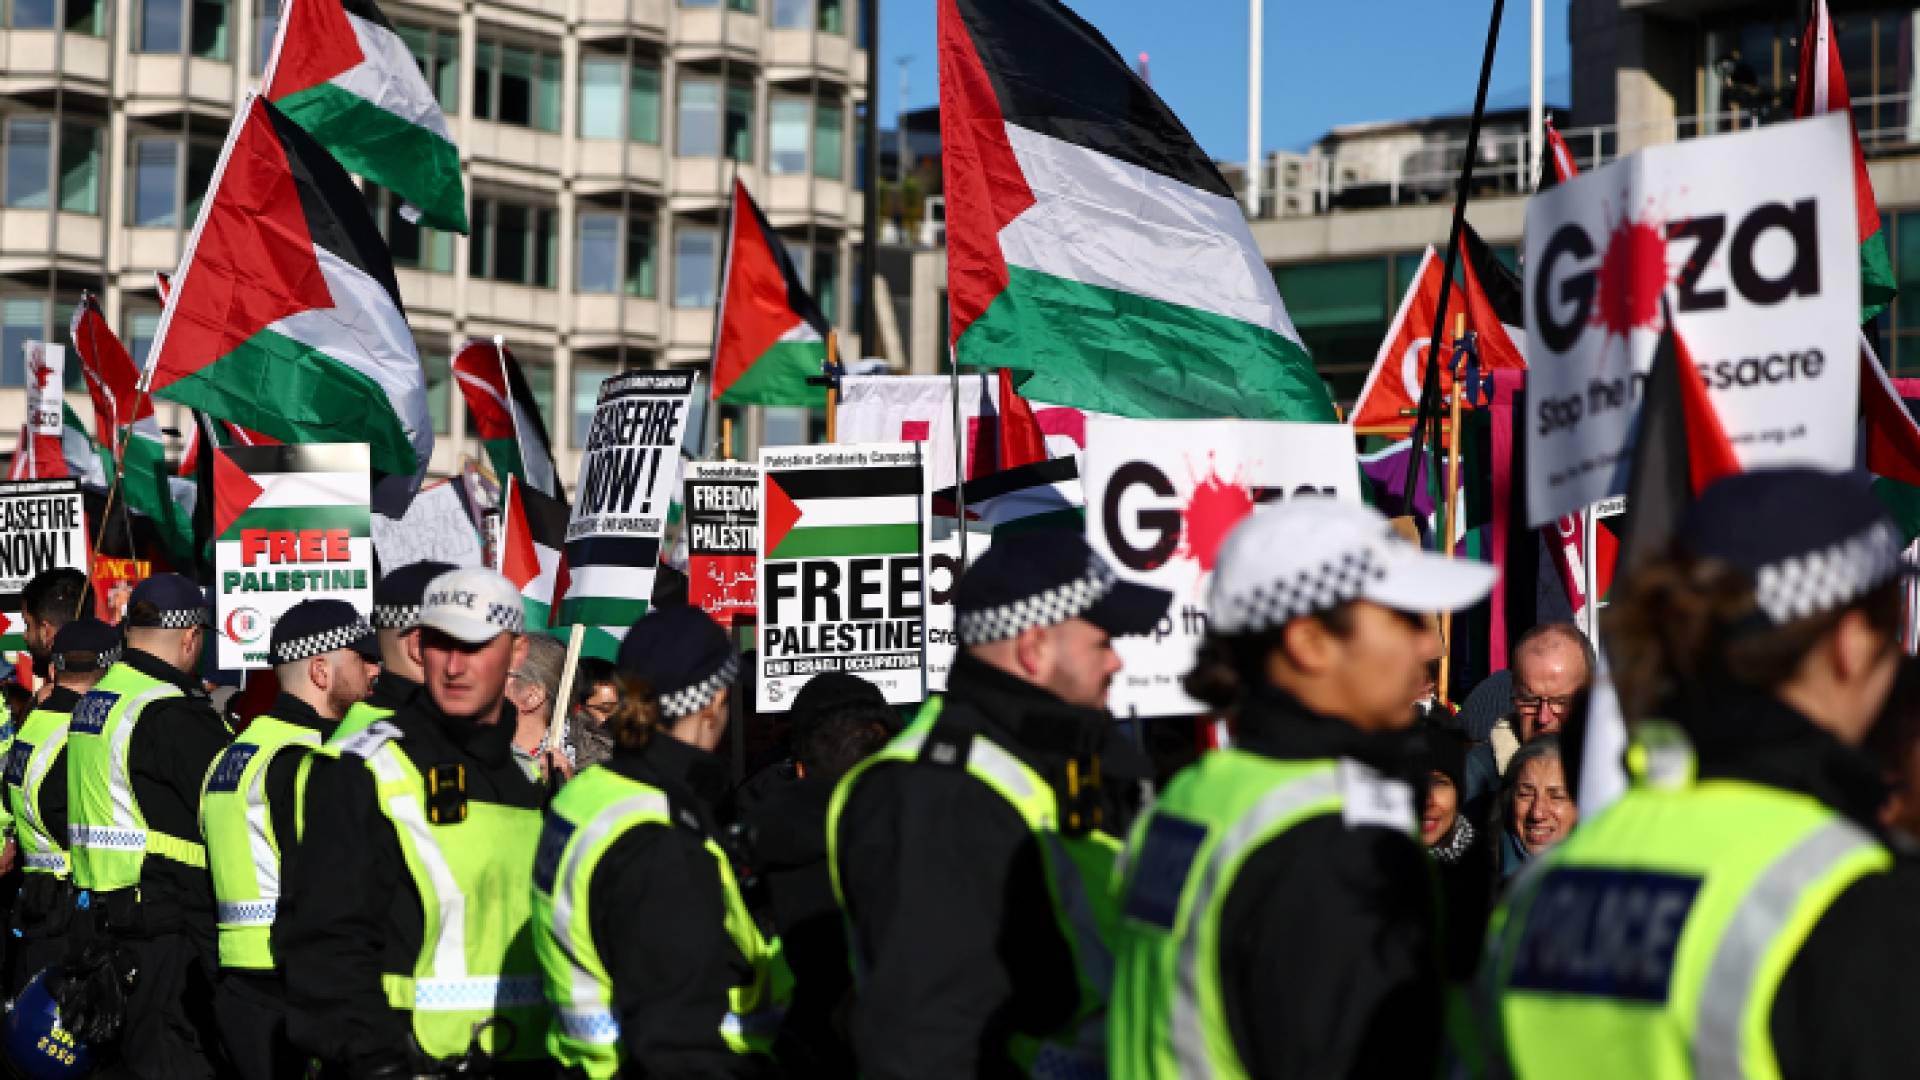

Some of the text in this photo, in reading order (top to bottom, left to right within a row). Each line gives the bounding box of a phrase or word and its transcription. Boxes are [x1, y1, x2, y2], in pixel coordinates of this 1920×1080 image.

[1535, 197, 1821, 353] Gza
[1632, 348, 1824, 402] ssacre
[764, 450, 922, 467] Palestine Solidarity Campaig
[578, 448, 662, 515] NOW!
[694, 486, 757, 510] FREEDO
[0, 532, 70, 577] NOW!
[241, 529, 351, 567] FREE
[693, 525, 757, 549] PALESTI
[224, 569, 368, 594] PALESTINE
[765, 559, 921, 625] FREE
[430, 591, 478, 609] POLICE
[765, 621, 921, 657] PALESTINE
[767, 660, 791, 675] END
[794, 657, 840, 674] ISRAELI
[845, 654, 920, 671] OCCUPATION
